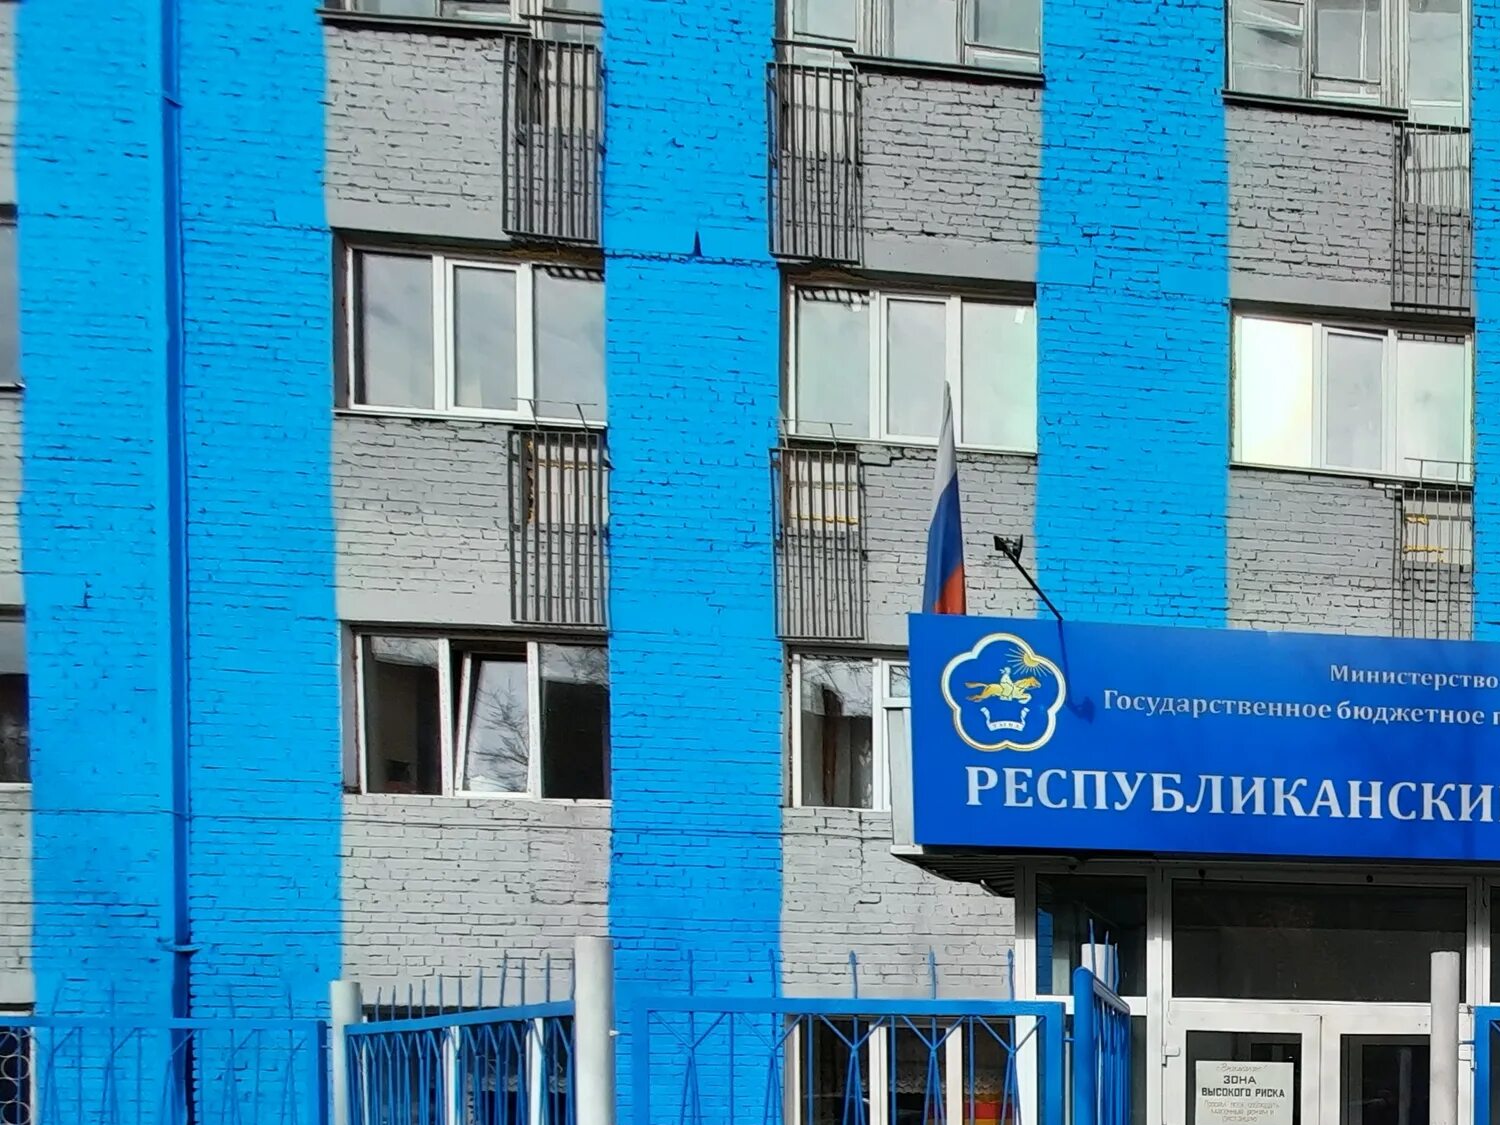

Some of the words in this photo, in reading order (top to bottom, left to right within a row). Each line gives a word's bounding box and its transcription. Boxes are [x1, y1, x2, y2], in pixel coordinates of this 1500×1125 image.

[1330, 664, 1500, 691] Министерство
[1103, 689, 1333, 719] Государственное
[1336, 700, 1486, 726] бюджетное
[1223, 1075, 1257, 1085] ЗОНА
[1201, 1087, 1251, 1097] ВЫСОКОГО
[1255, 1088, 1285, 1098] РИСКА
